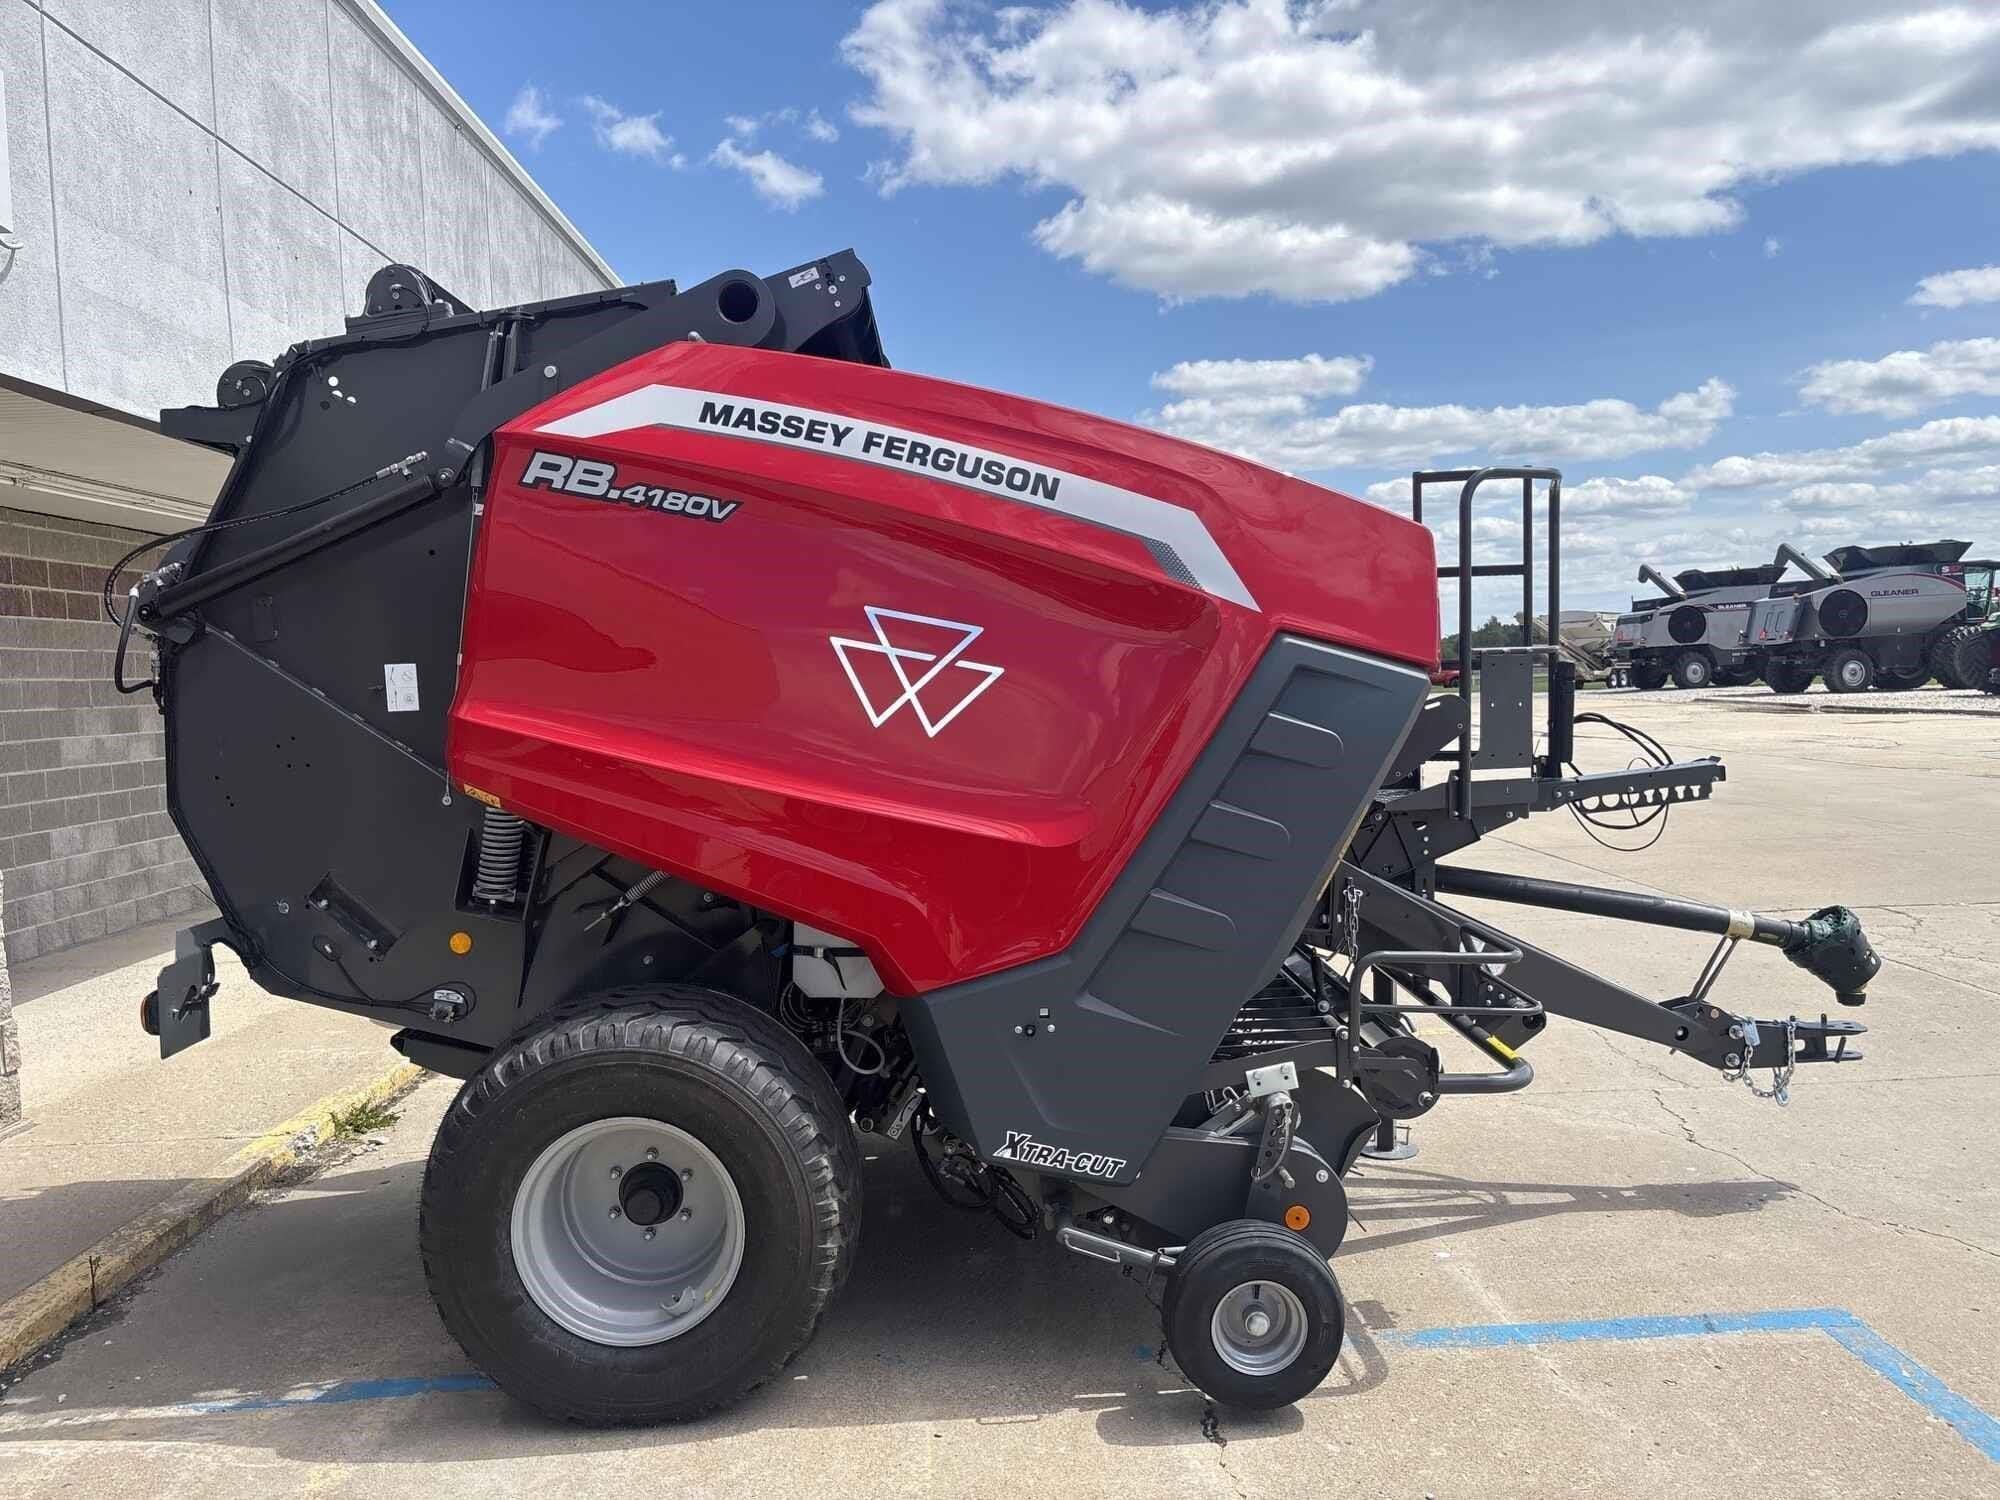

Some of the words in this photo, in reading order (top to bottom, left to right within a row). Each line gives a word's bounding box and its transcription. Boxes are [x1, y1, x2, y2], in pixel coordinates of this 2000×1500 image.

[698, 401, 853, 448] MASSEY
[861, 431, 1062, 501] FERGUSON
[1870, 589, 1920, 597] GLEANER
[992, 1130, 1127, 1178] XTRA-CUT
